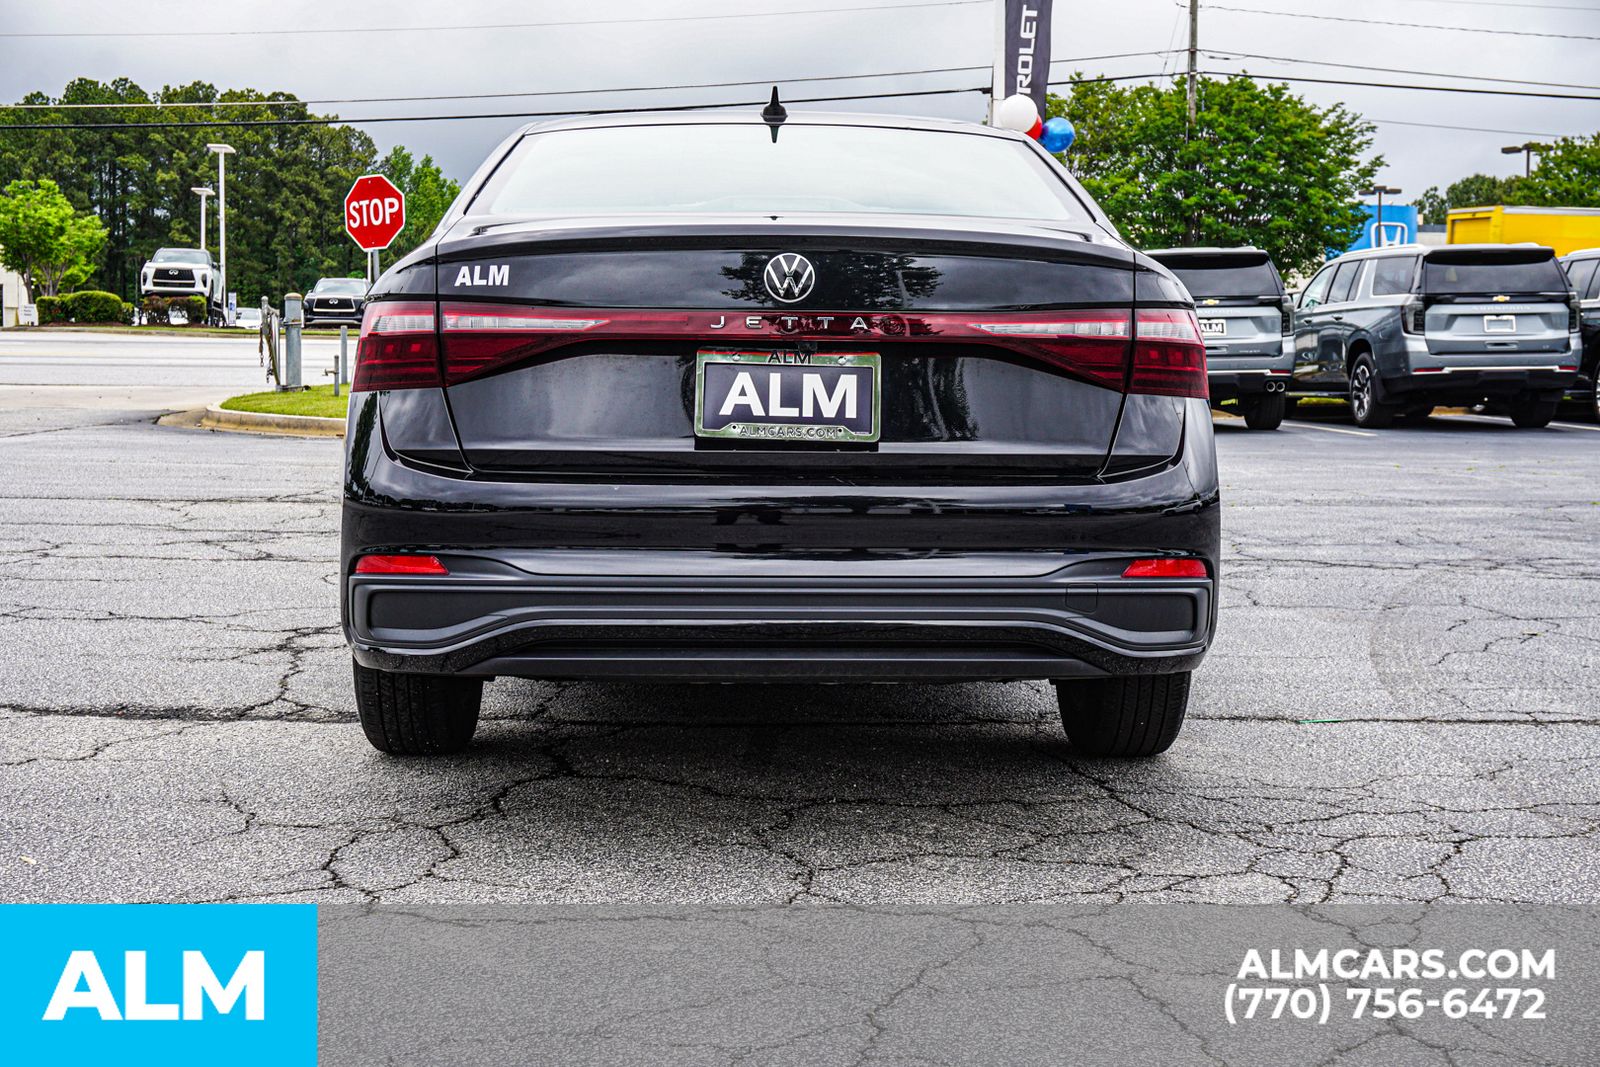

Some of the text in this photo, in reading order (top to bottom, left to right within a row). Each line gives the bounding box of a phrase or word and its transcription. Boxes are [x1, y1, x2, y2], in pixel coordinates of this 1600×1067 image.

[1016, 4, 1038, 95] ROLET
[349, 197, 399, 229] STOP
[454, 265, 510, 286] ALM
[710, 315, 868, 329] JETTA
[767, 351, 812, 364] ALM
[718, 372, 858, 419] ALM
[738, 426, 838, 439] ALMCARS.COM
